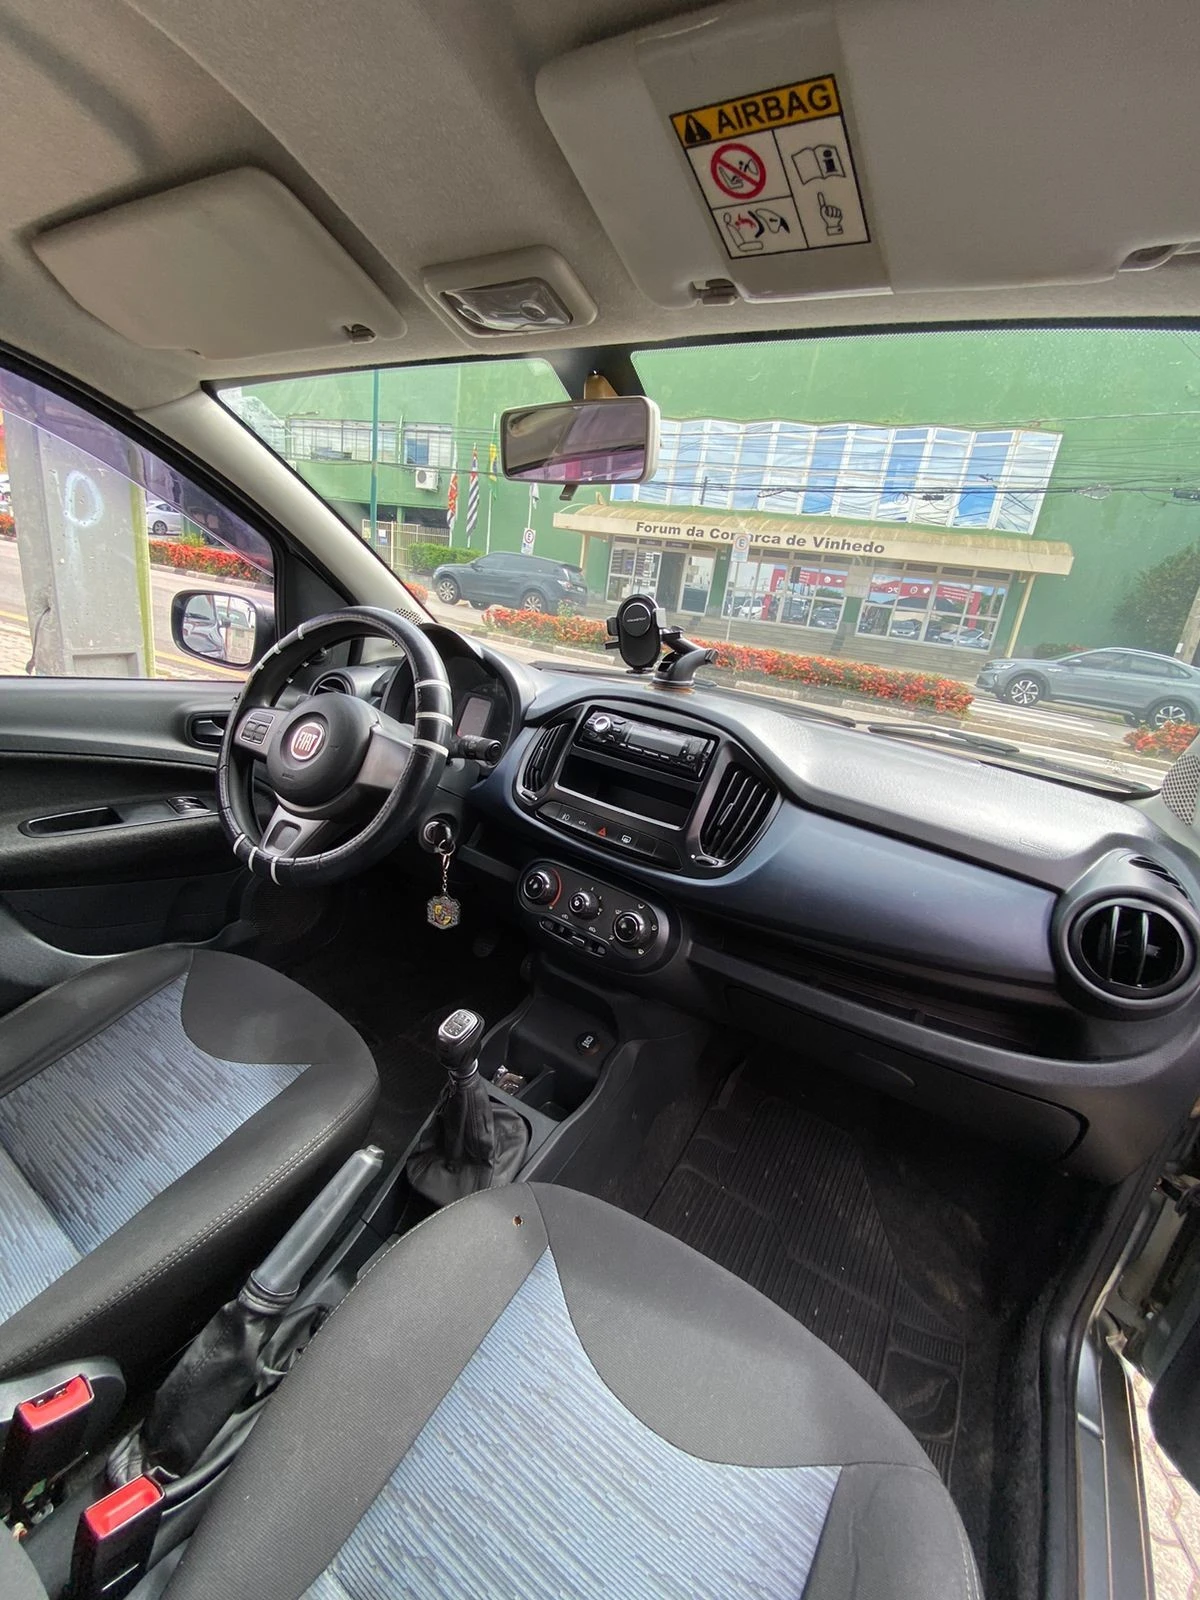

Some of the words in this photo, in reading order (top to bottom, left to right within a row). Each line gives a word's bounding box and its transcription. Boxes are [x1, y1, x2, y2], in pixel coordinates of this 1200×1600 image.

[717, 83, 833, 134] AIRBAG
[636, 522, 681, 535] Forum
[686, 526, 704, 538] da
[709, 528, 782, 545] Corca
[786, 534, 807, 547] de
[813, 536, 885, 554] Vinhedo
[295, 731, 319, 752] FIAT
